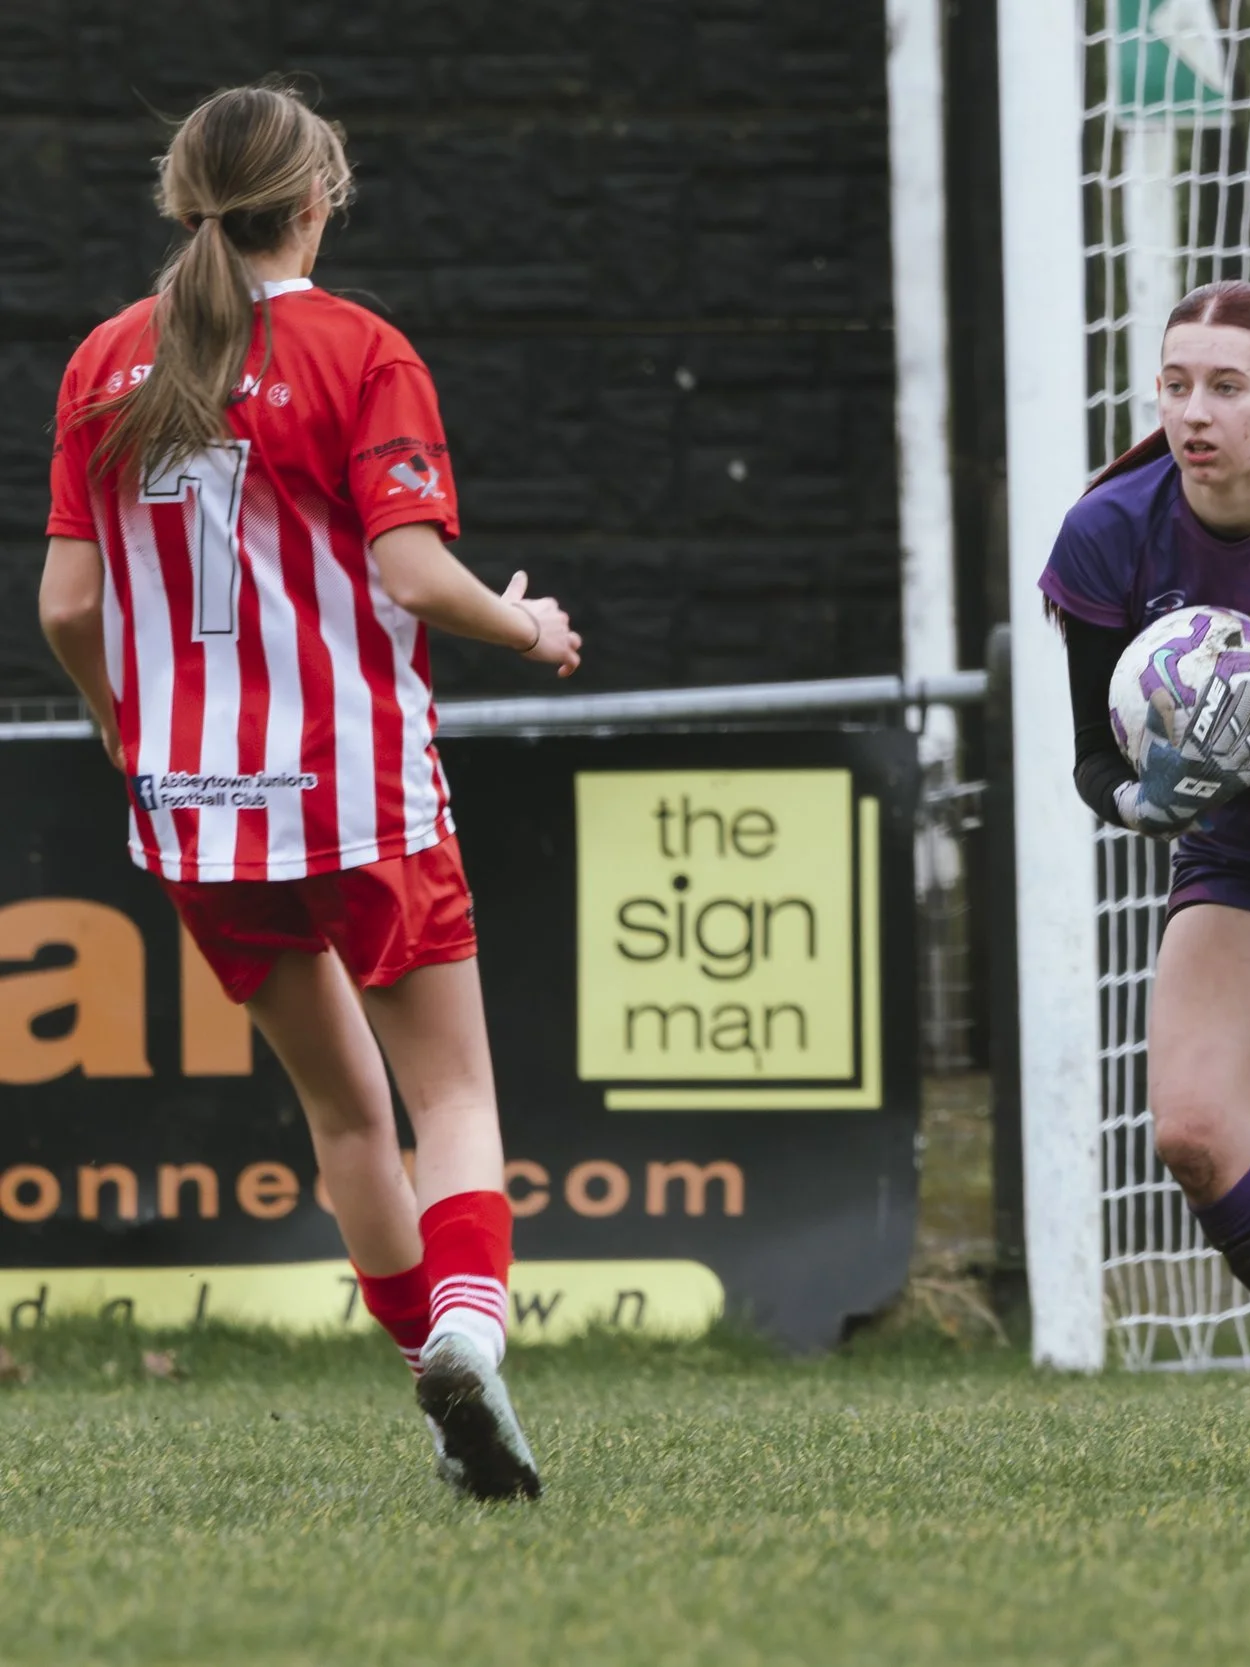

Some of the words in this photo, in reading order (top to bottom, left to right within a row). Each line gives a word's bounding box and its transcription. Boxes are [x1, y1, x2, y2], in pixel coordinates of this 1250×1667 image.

[139, 439, 251, 643] 7
[1192, 676, 1227, 743] ONE
[160, 773, 252, 791] Abbeytown
[256, 772, 316, 788] Juniors
[161, 792, 225, 807] Football
[231, 792, 267, 807] Club
[654, 795, 778, 859] the
[615, 873, 818, 982] sign
[624, 1002, 809, 1053] man
[338, 1276, 647, 1326] Twn
